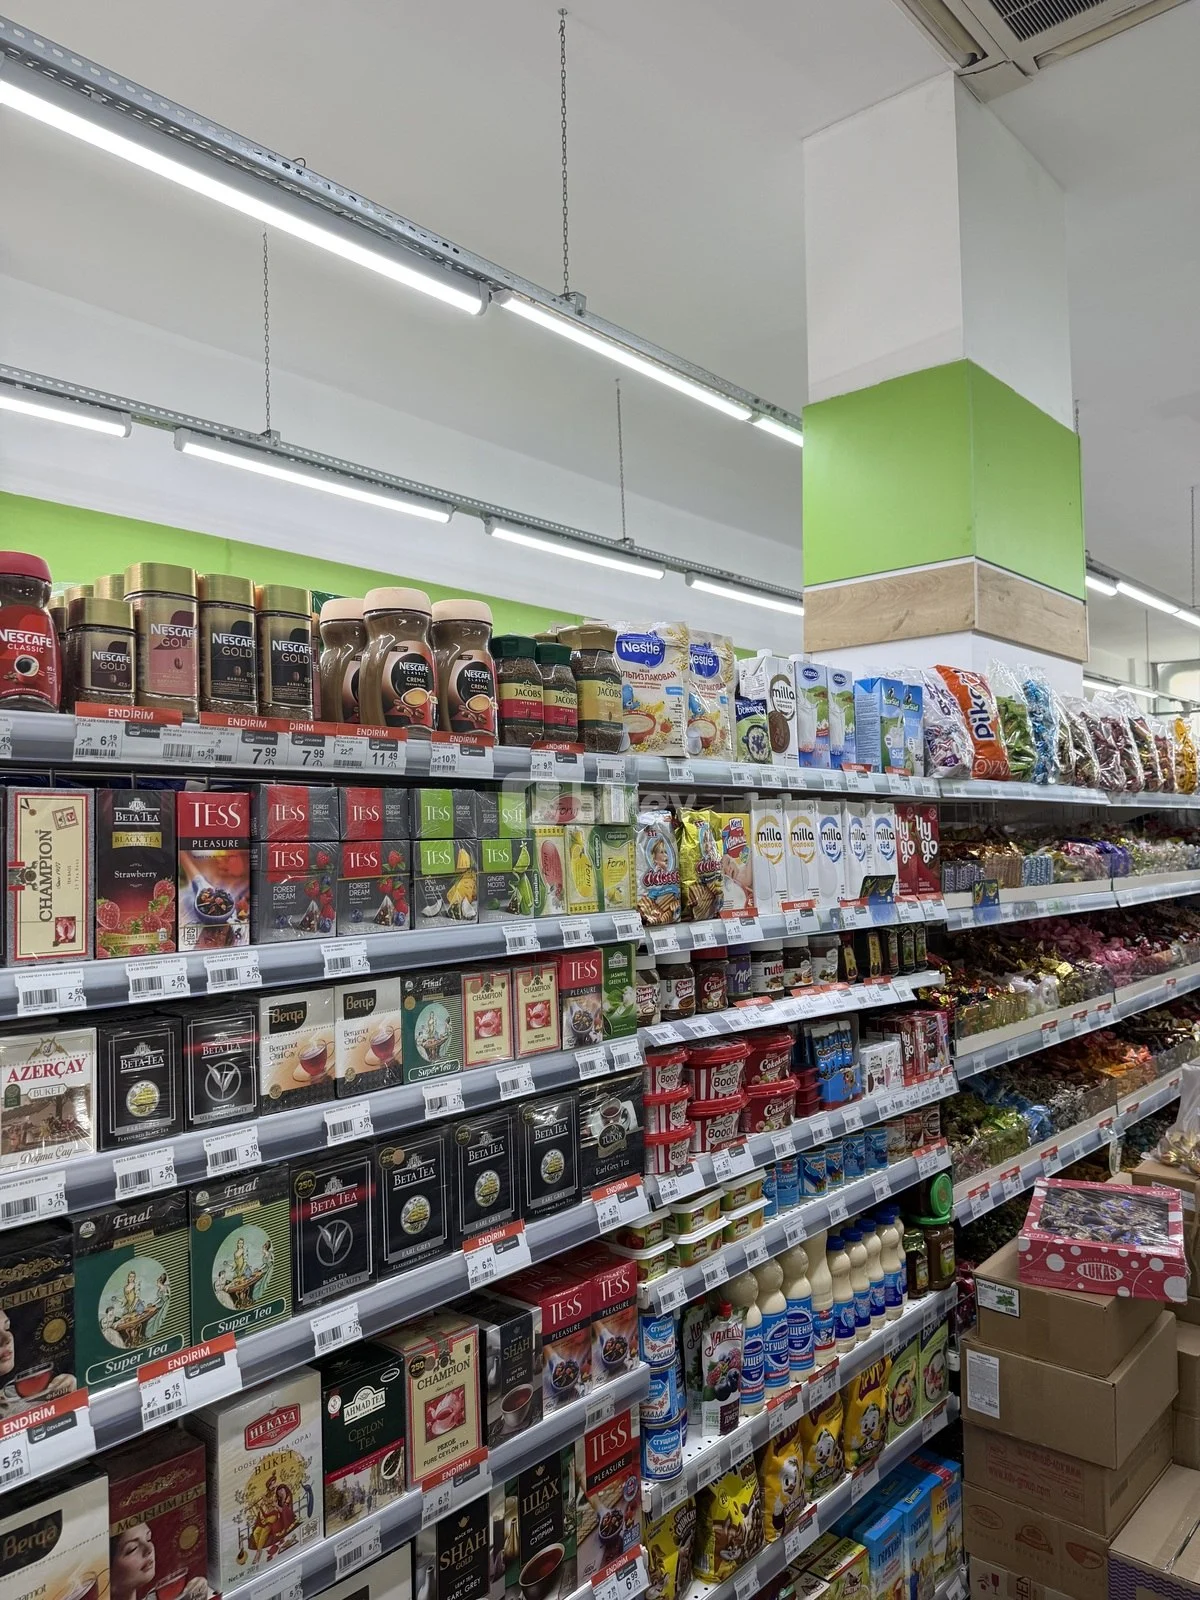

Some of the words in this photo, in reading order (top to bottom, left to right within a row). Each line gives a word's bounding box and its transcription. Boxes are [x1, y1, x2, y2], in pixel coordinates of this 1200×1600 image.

[8, 644, 44, 653] CLASSIC
[161, 638, 193, 648] GOLD
[222, 647, 252, 658] GOLD
[281, 653, 309, 664] GOLD
[100, 662, 126, 671] GOLD
[515, 688, 541, 698] JACOBS
[555, 696, 577, 705] JACOBS
[598, 687, 621, 698] JACOBS
[773, 686, 795, 700] milla
[109, 708, 153, 720] ENDİRİM
[101, 736, 106, 745] 6
[253, 749, 262, 764] 7
[265, 748, 276, 756] 99
[302, 751, 311, 765] 7
[314, 750, 324, 758] 99
[373, 753, 384, 765] 11
[116, 812, 140, 822] BETA
[141, 812, 158, 821] TEA
[189, 802, 240, 828] TESS
[272, 804, 305, 822] TESS
[352, 805, 379, 822] TESS
[425, 805, 450, 821] TESS
[757, 828, 782, 840] milla
[791, 828, 814, 840] milla
[822, 829, 841, 841] milla
[876, 830, 895, 839] milla
[192, 840, 238, 848] PLEASURE
[272, 850, 304, 868] TESS
[348, 851, 378, 868] TESS
[424, 850, 450, 865] TESS
[486, 849, 509, 863] TESS
[39, 830, 52, 922] CHAMPION
[570, 959, 597, 981] TESS
[473, 991, 502, 1001] CHAMPION
[524, 984, 550, 993] CHAMPION
[571, 987, 596, 995] PLEASURE
[346, 996, 374, 1010] Berqa
[272, 1009, 304, 1024] Berqa
[344, 1028, 369, 1038] Bergamot
[203, 1044, 224, 1055] BETA
[226, 1042, 240, 1050] TEA
[269, 1042, 298, 1052] Bergamot
[120, 1058, 145, 1069] BETA
[145, 1055, 164, 1065] TEA
[7, 1058, 86, 1083] AZERÇAY
[33, 1088, 62, 1097] BUKET
[535, 1128, 553, 1140] BETA
[554, 1123, 567, 1133] TEA
[602, 1132, 622, 1144] TUDOR
[20, 1152, 53, 1164] Doğma
[56, 1146, 73, 1159] Çay
[469, 1149, 488, 1161] BETA
[489, 1142, 503, 1153] TEA
[596, 1166, 606, 1175] Earl
[607, 1163, 618, 1171] Grey
[620, 1160, 629, 1168] Tea
[394, 1174, 417, 1186] BETA
[418, 1167, 434, 1178] TEA
[224, 1179, 257, 1198] Final
[48, 1198, 53, 1206] 3
[310, 1198, 335, 1214] BETA
[337, 1192, 357, 1204] TEA
[113, 1206, 151, 1229] Final
[476, 1219, 489, 1229] EARL
[490, 1215, 501, 1223] GREY
[401, 1247, 416, 1258] EARL
[417, 1242, 431, 1252] GREY
[323, 1276, 337, 1285] BLACK
[1083, 1265, 1117, 1281] LUKAS
[600, 1274, 629, 1301] TESS
[550, 1293, 582, 1325] TESS
[602, 1301, 630, 1316] PLEASURE
[217, 1315, 250, 1333] Super
[253, 1304, 271, 1320] Tea
[552, 1323, 580, 1341] PLEASURE
[503, 1338, 530, 1361] SHAH
[105, 1353, 143, 1374] Super
[147, 1343, 167, 1358] Tea
[168, 1347, 210, 1370] ENDİRİM
[411, 1361, 424, 1373] 250
[417, 1359, 471, 1390] CHAMPION
[164, 1390, 170, 1400] 5
[173, 1383, 180, 1392] 15
[345, 1400, 370, 1421] AHMAD
[371, 1395, 385, 1405] TEA
[2, 1404, 55, 1435] ENDİRİM
[250, 1410, 295, 1439] HEKAYA
[350, 1418, 384, 1441] CEYLON
[359, 1438, 376, 1450] TEA
[437, 1438, 456, 1451] PEKOE
[590, 1419, 627, 1463] TESS
[3, 1457, 10, 1468] 5
[12, 1450, 21, 1458] 29
[234, 1459, 256, 1473] LOOSE
[258, 1452, 276, 1463] LEAF
[278, 1444, 290, 1453] TEA
[292, 1432, 311, 1447] (OPA)
[424, 1458, 437, 1467] PURE
[438, 1449, 458, 1461] CEYLON
[460, 1440, 469, 1449] TEA
[255, 1451, 293, 1476] BUKET
[594, 1458, 625, 1483] PLEASURE
[523, 1478, 560, 1517] ШАХ
[118, 1496, 177, 1532] MOUSLUM
[180, 1487, 198, 1502] TEA
[534, 1502, 550, 1516] GOLD
[3, 1525, 57, 1560] Berqa
[440, 1527, 488, 1571] SHAH
[455, 1556, 473, 1571] GOLD
[447, 1588, 463, 1600] EARL
[464, 1577, 482, 1594] GREY
[626, 1578, 632, 1590] 6
[631, 1571, 637, 1580] 99
